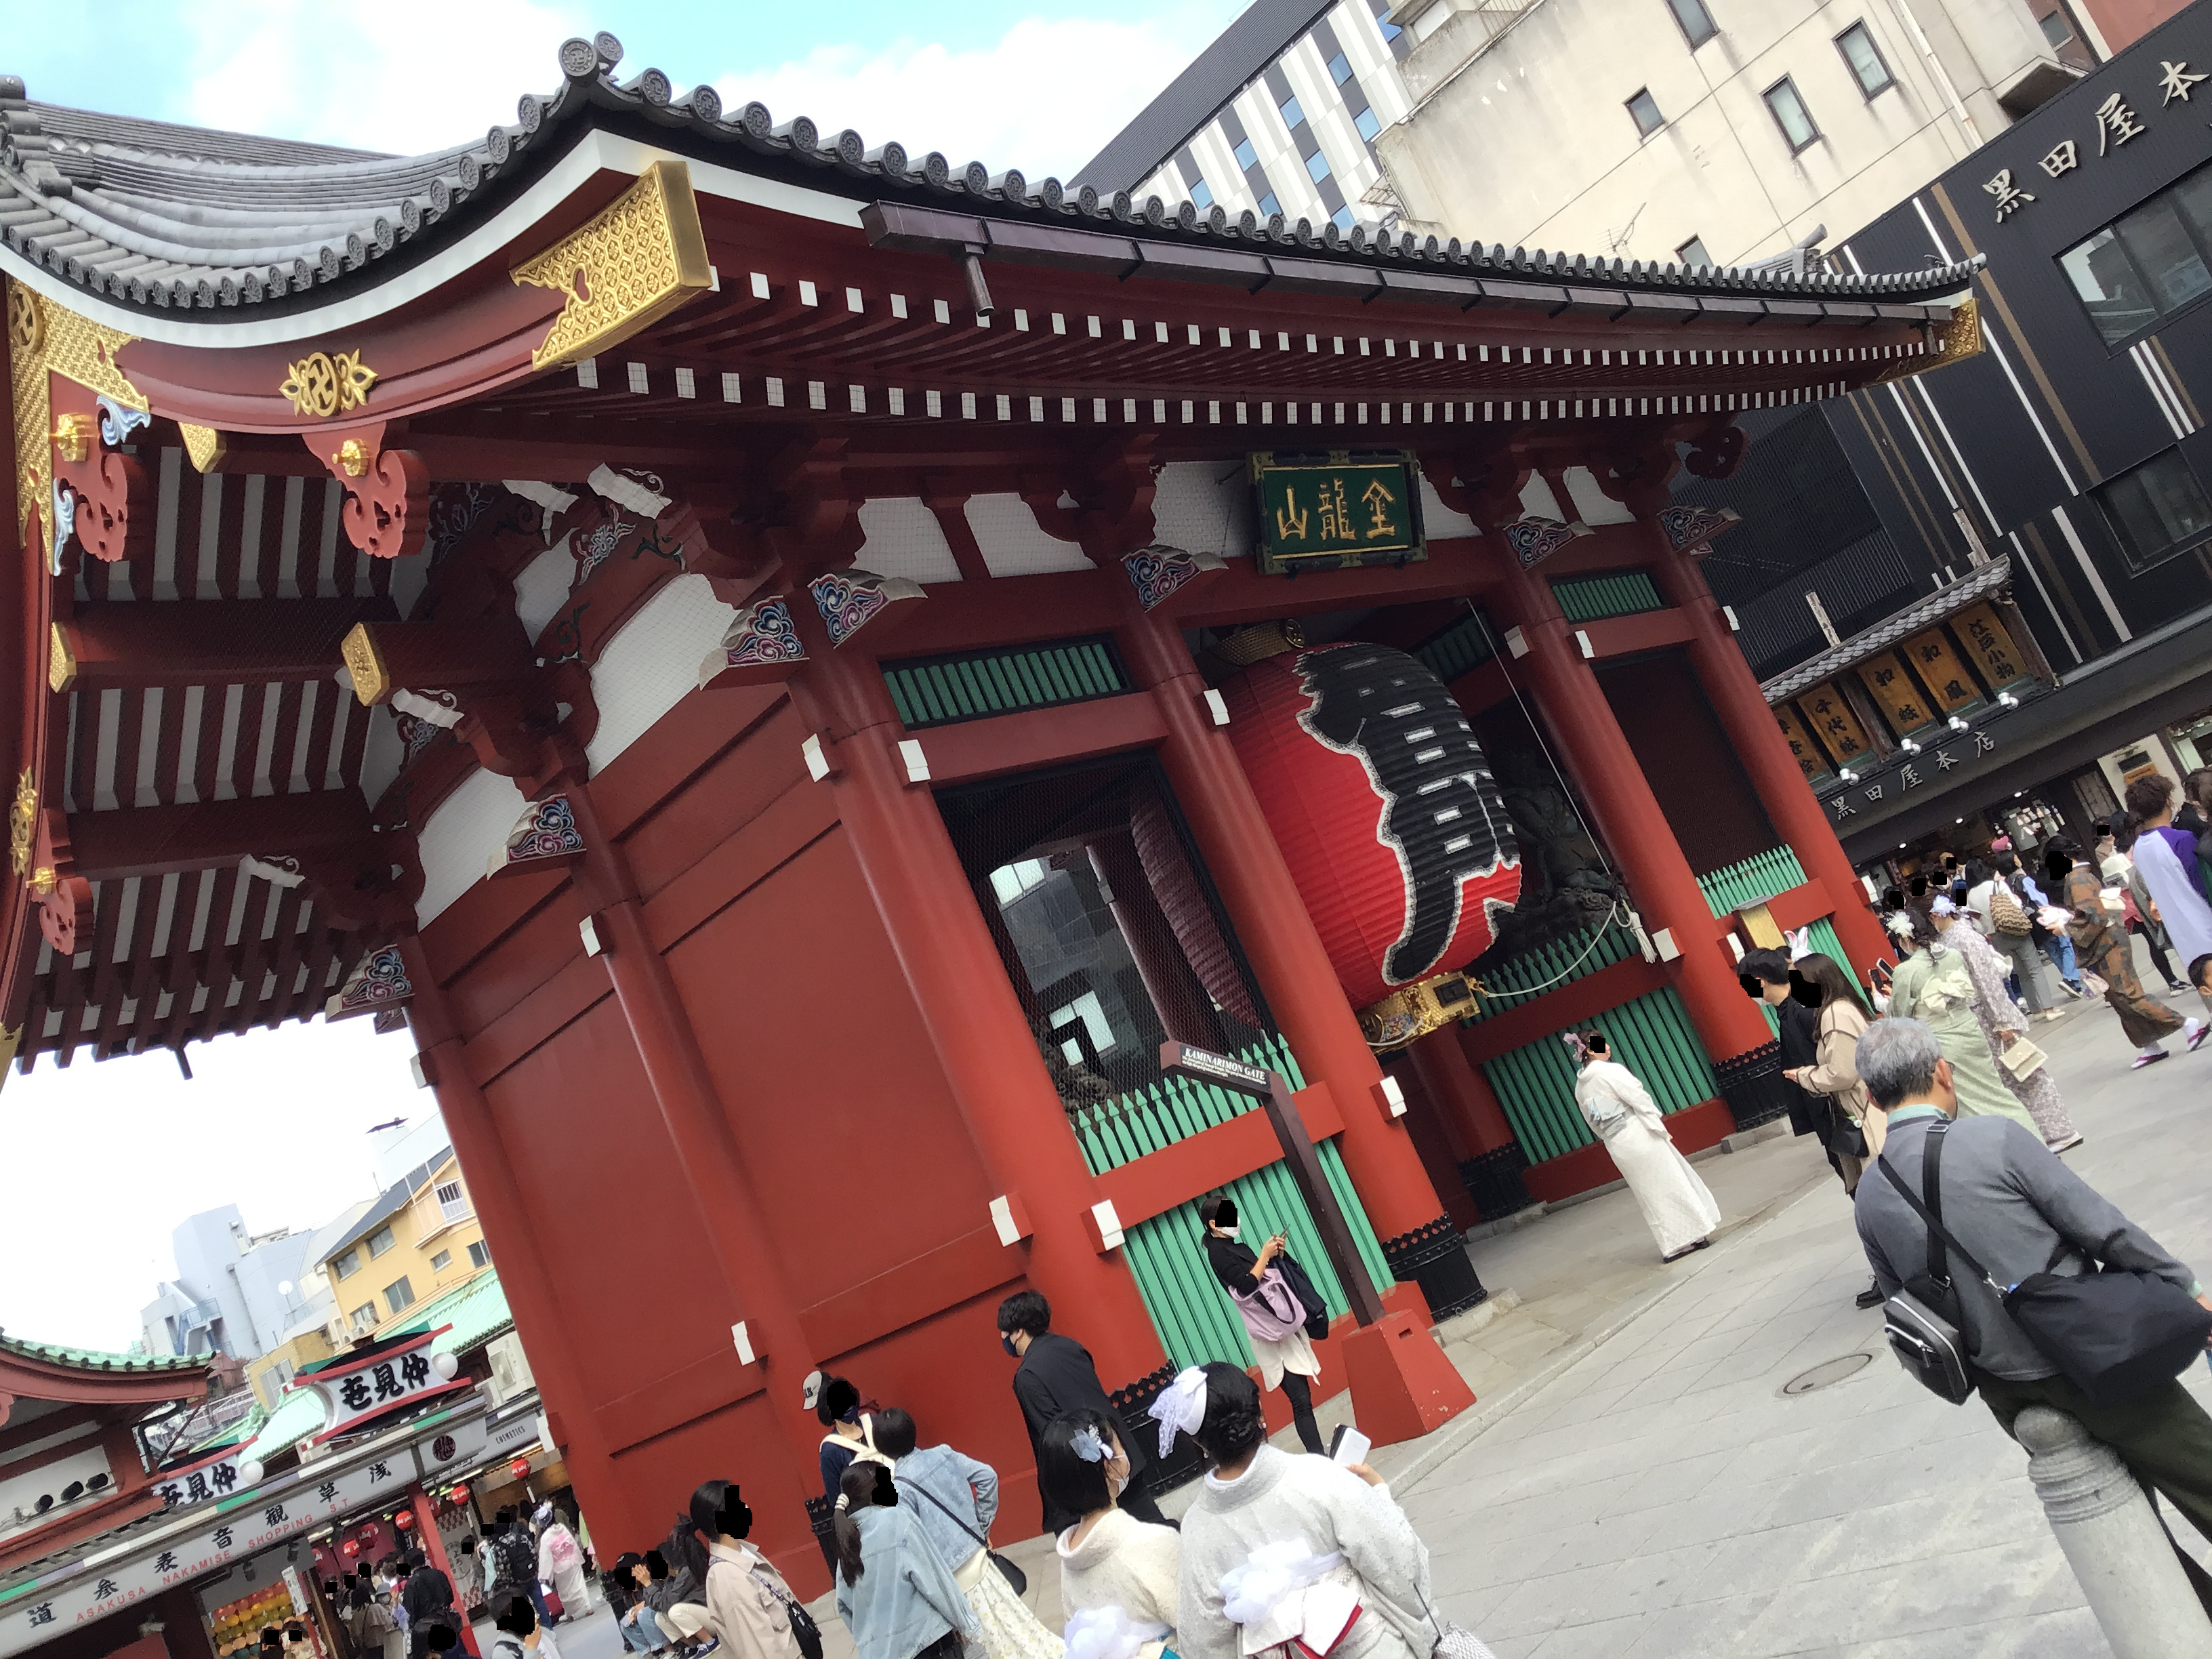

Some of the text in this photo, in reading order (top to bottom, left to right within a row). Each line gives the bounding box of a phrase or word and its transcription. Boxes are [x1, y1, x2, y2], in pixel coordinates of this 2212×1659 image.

[1982, 60, 2210, 224] 黒田屋本
[1276, 476, 1395, 540] 金龍山
[1830, 731, 1996, 821] 黒田屋本店
[1185, 1048, 1244, 1073] KAMINARIMON
[1244, 1066, 1266, 1081] GATE
[495, 1425, 526, 1445] COSMETICS
[76, 1586, 147, 1622] ASAKUSA
[162, 1550, 232, 1585] NAKAMISE
[247, 1514, 314, 1549] SHOPPING
